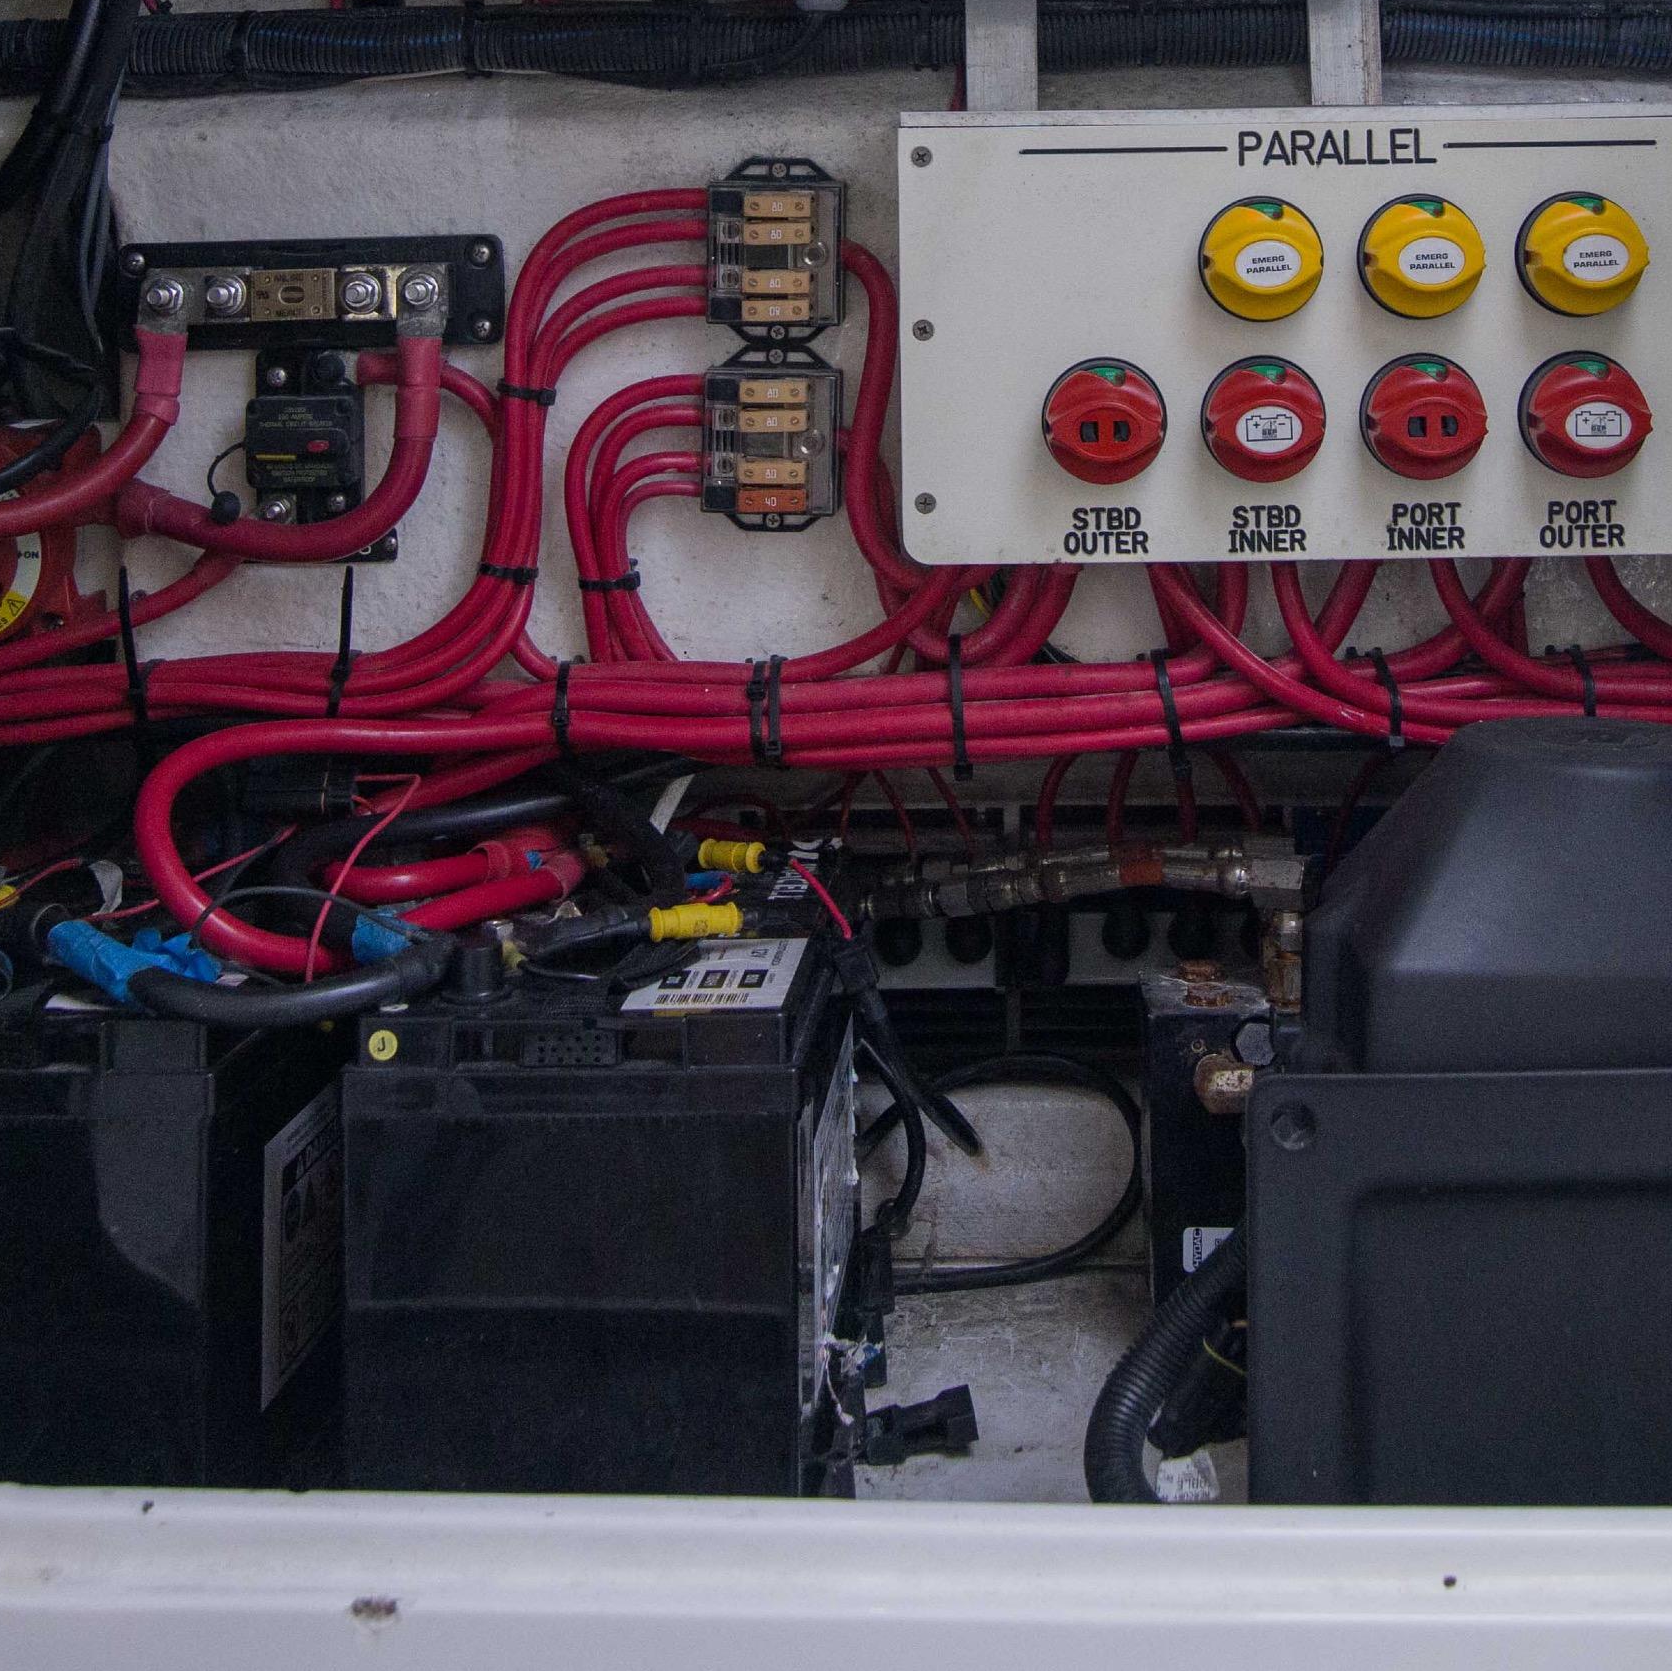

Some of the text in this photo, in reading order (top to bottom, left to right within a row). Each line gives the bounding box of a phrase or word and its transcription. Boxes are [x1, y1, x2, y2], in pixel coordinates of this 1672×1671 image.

[1238, 128, 1437, 166] PARALLEL
[1252, 255, 1285, 265] EMERG
[1409, 260, 1456, 270] PARALLEL
[1415, 252, 1449, 262] EMERG
[1573, 258, 1619, 268] PARALLEL
[1579, 249, 1612, 259] EMERG
[1246, 264, 1292, 274] PARALLEL
[765, 496, 777, 507] 40
[1548, 500, 1617, 525] PORT
[1072, 507, 1141, 530] STBD
[1232, 504, 1301, 529] STBD
[1392, 502, 1461, 527] PORT
[1063, 530, 1149, 555] OUTER
[1228, 529, 1307, 553] INNER
[1387, 526, 1465, 551] INNER
[1539, 524, 1625, 548] OUTER
[23, 551, 39, 559] ON
[377, 1036, 386, 1052] J
[1193, 1229, 1202, 1269] HYDAC
